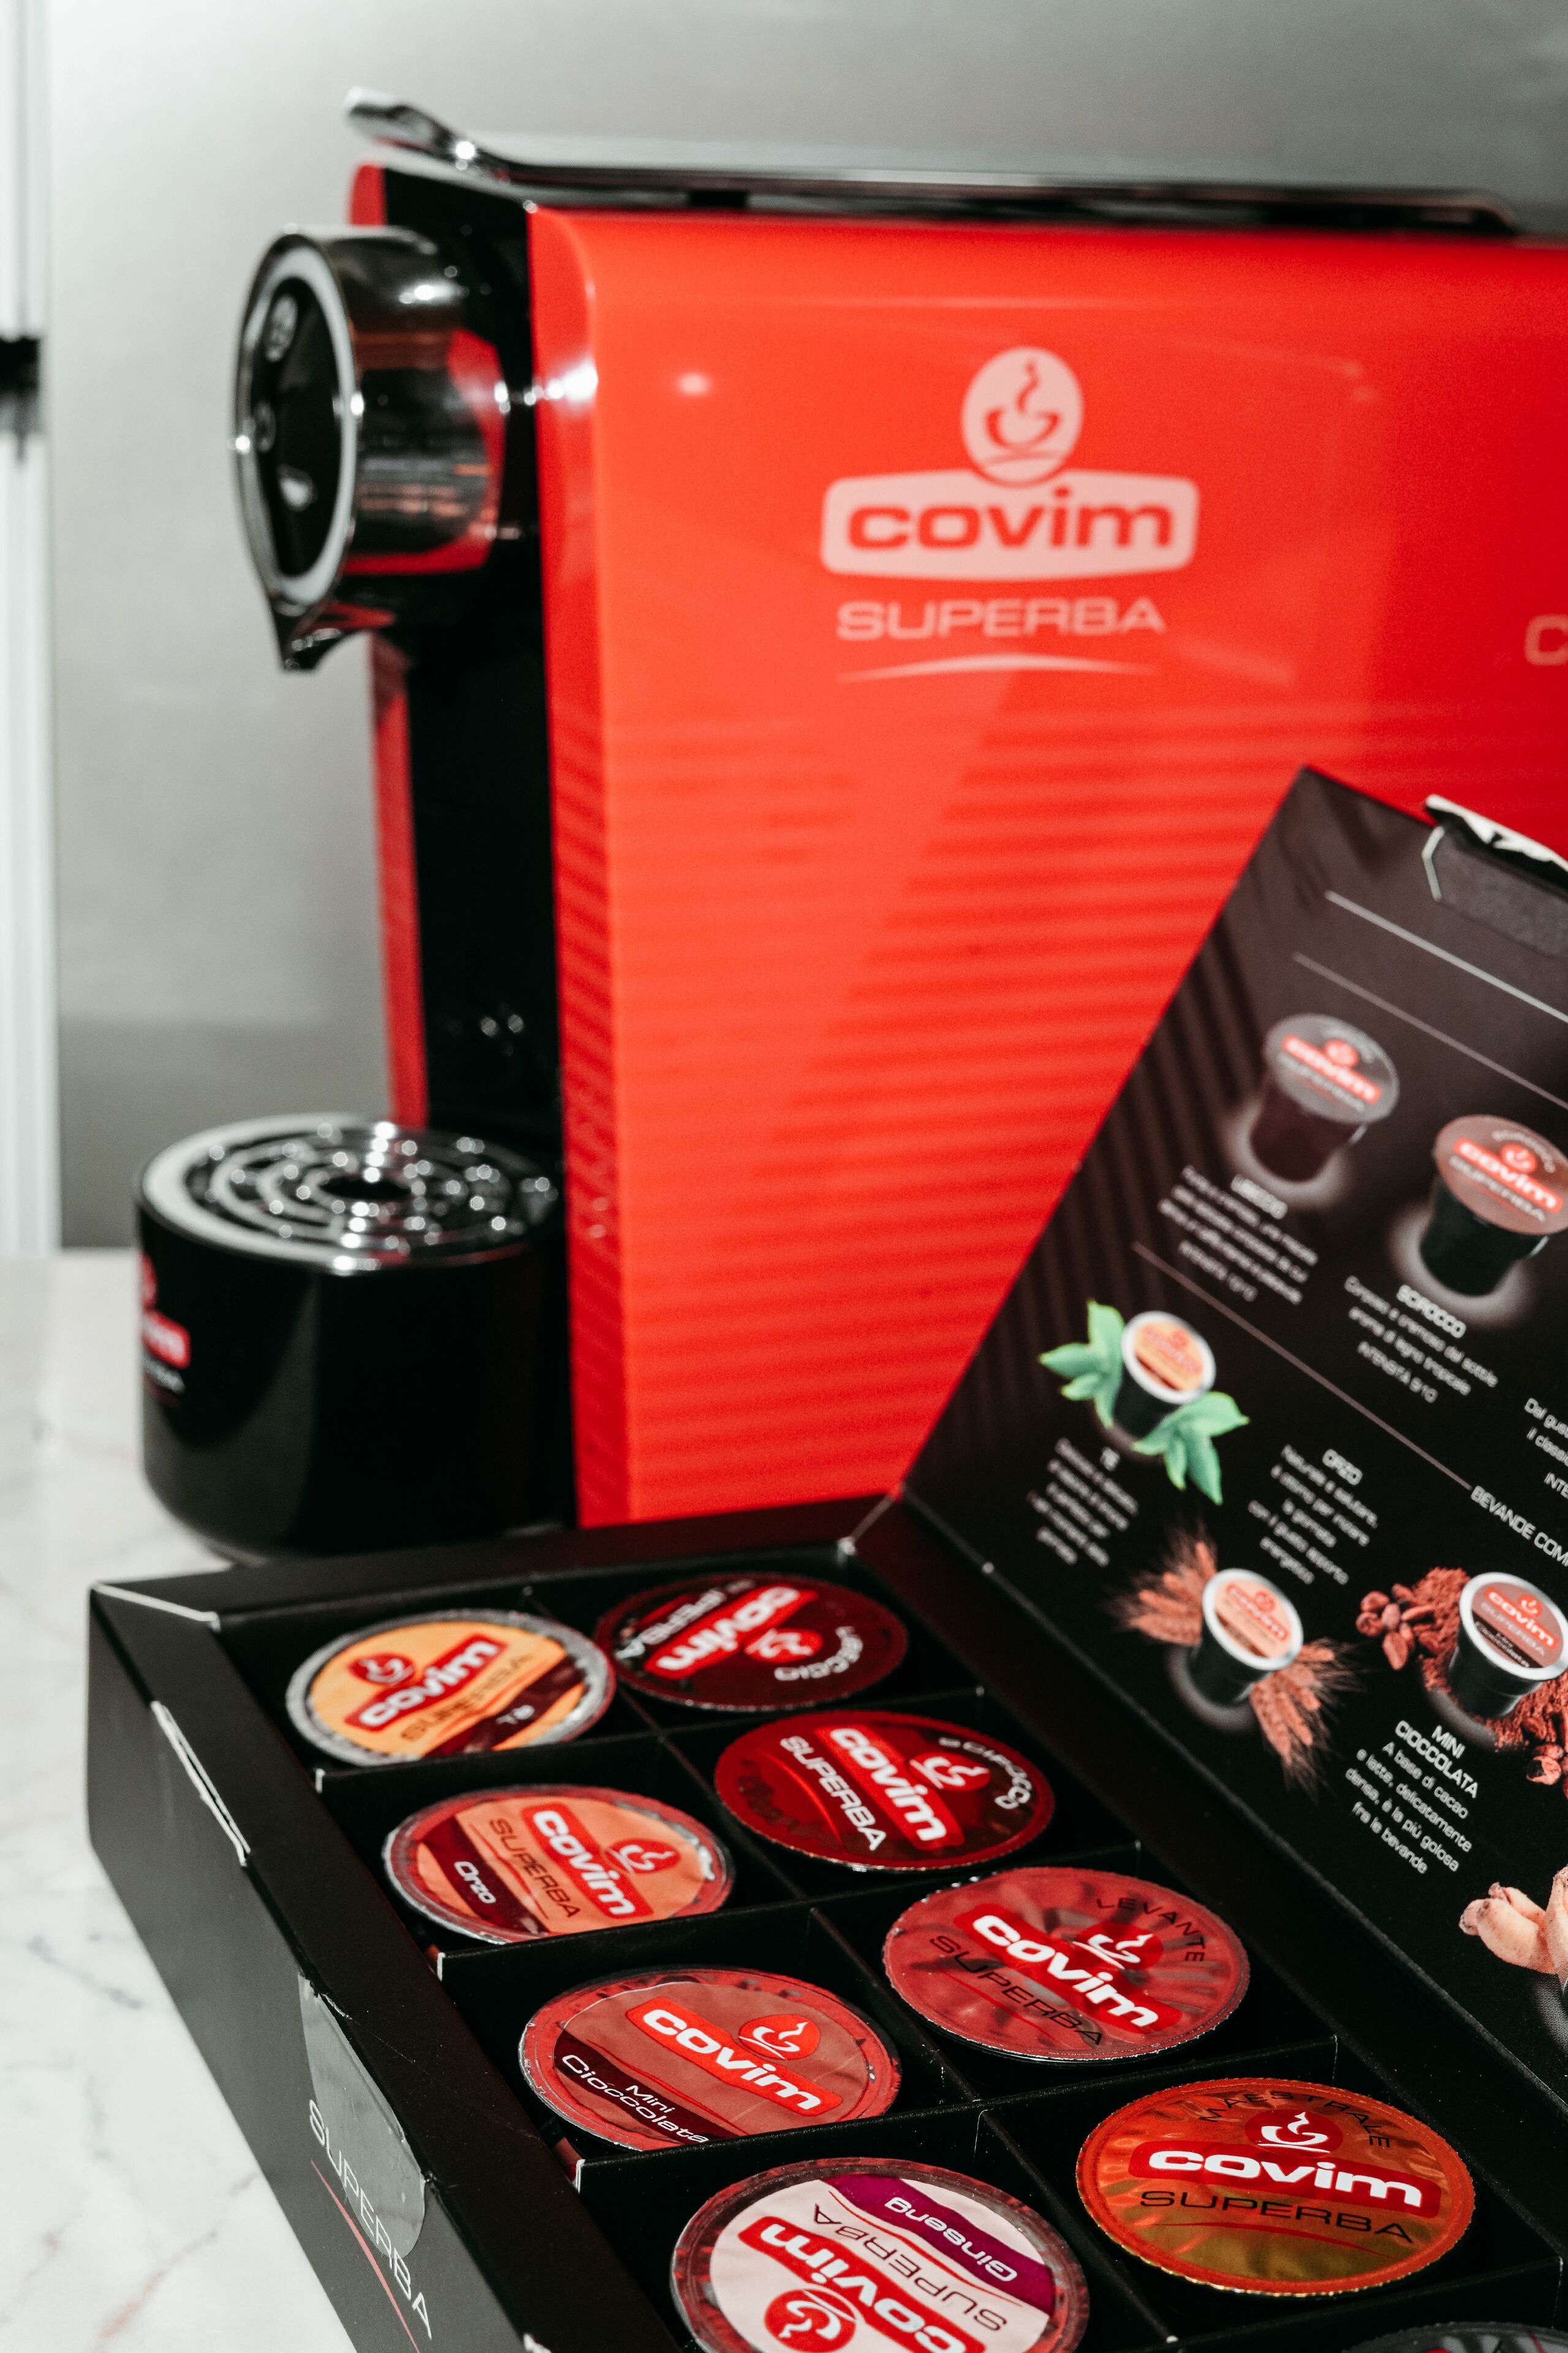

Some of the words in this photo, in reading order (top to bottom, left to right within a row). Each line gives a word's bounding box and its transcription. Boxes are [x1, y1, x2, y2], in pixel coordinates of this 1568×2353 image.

[847, 486, 1173, 550] covim
[836, 597, 1166, 640] SUPERBA
[1524, 1398, 1547, 1419] Dal
[1471, 1486, 1536, 1539] BEVANDE
[1534, 1532, 1568, 1566] COM
[656, 1586, 800, 1671] covim
[1488, 1591, 1556, 1647] covim
[358, 1640, 497, 1726] covim
[1382, 1742, 1394, 1756] A
[1422, 1776, 1434, 1789] di
[1434, 1787, 1468, 1819] cacao
[1395, 1721, 1477, 1798] CIOCCOLATA
[1432, 1726, 1465, 1758] MINI
[779, 1735, 887, 1851] SUPERBA
[830, 1727, 947, 1842] covim
[1396, 1784, 1472, 1852] delicatamente
[489, 1817, 580, 1919] SUPERBA
[532, 1811, 635, 1915] covim
[1382, 1828, 1427, 1873] bevande
[1392, 1807, 1404, 1822] la
[1402, 1819, 1422, 1838] più
[1420, 1836, 1459, 1871] golosa
[454, 1860, 496, 1904] Orzo
[1096, 1896, 1205, 1963] LEVANTE
[930, 1934, 1102, 2047] SUPERBA
[972, 1914, 1159, 2028] covim
[642, 2008, 822, 2110] covim
[561, 2054, 709, 2144] Cioccolata
[626, 2084, 676, 2115] Mini
[1199, 2090, 1390, 2148] MAESTRALE
[1140, 2190, 1414, 2244] SUPERBA
[1148, 2150, 1423, 2208] covim
[309, 2099, 432, 2340] SUPERBA
[884, 2196, 1018, 2283] Ginseng
[759, 2222, 968, 2353] covim
[812, 2202, 1009, 2332] SUPERBA
